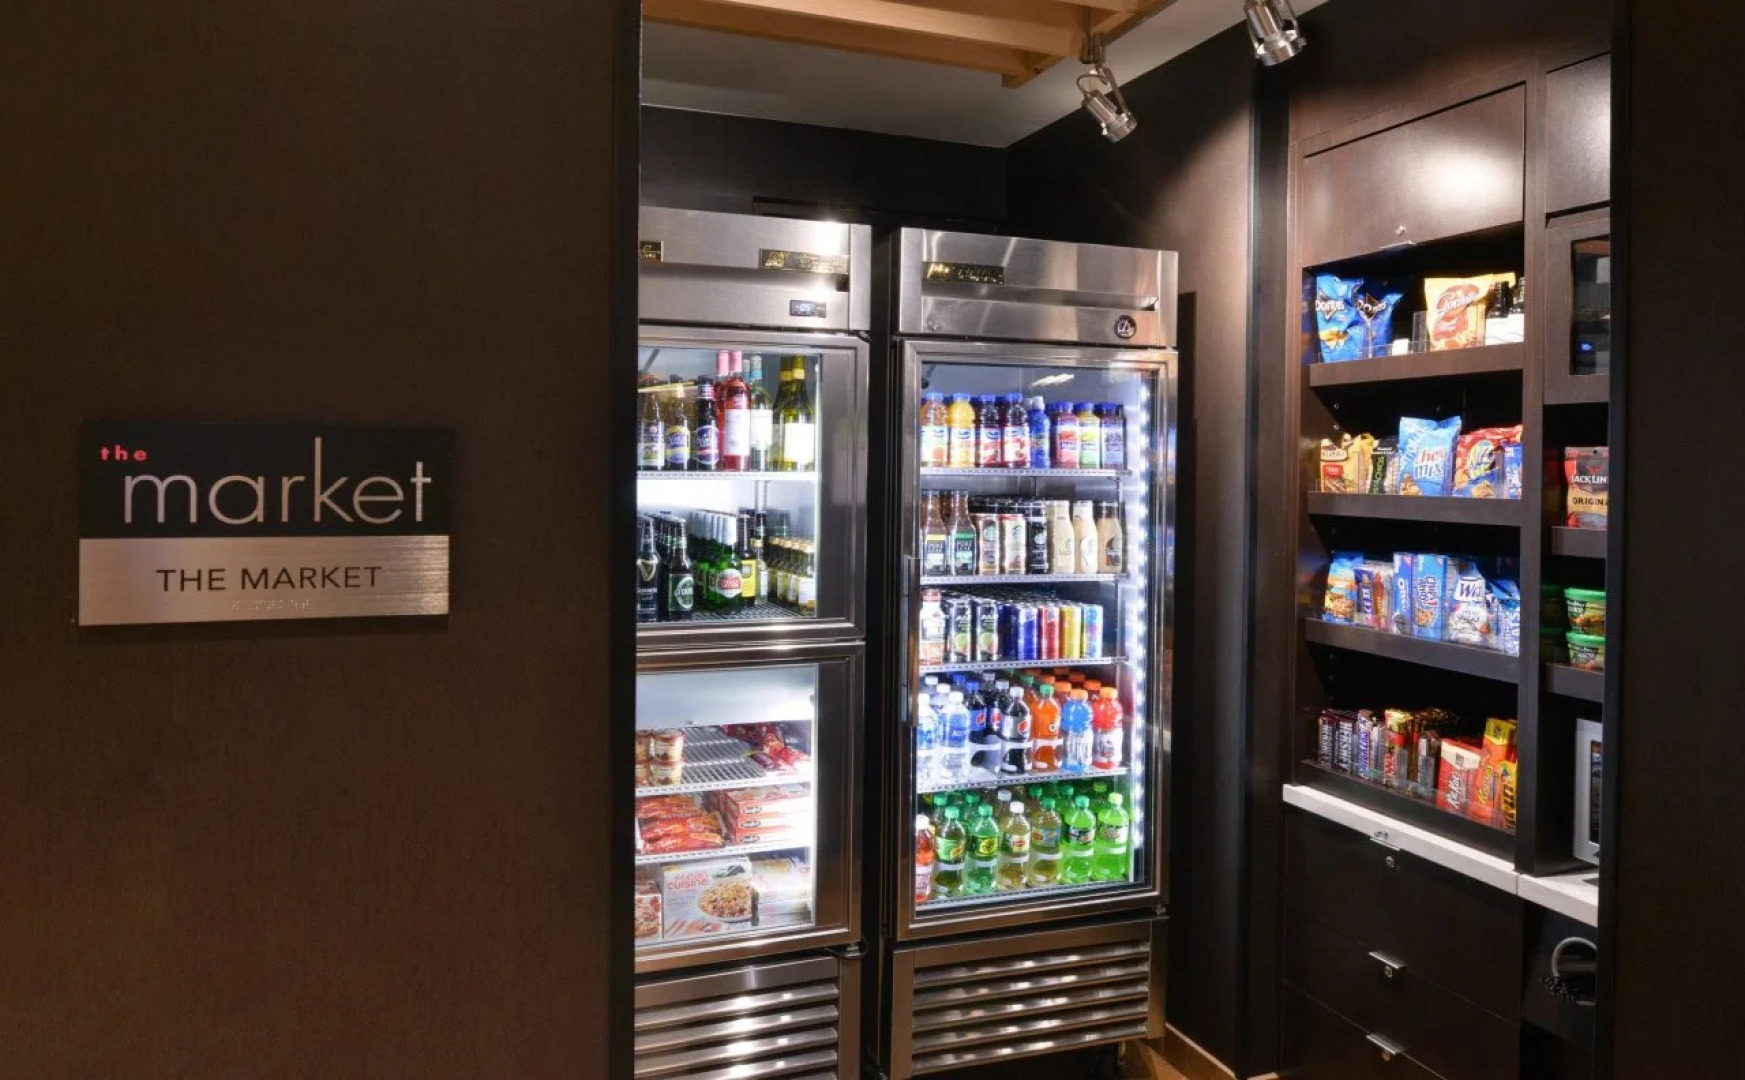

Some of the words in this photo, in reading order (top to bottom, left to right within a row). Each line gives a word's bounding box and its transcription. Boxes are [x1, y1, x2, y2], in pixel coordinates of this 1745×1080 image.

[1315, 299, 1345, 312] Doritos
[100, 445, 148, 461] the
[124, 436, 432, 525] market
[1571, 475, 1591, 485] JACK
[1591, 475, 1608, 485] LIN
[156, 568, 226, 593] THE
[241, 565, 382, 590] MARKET
